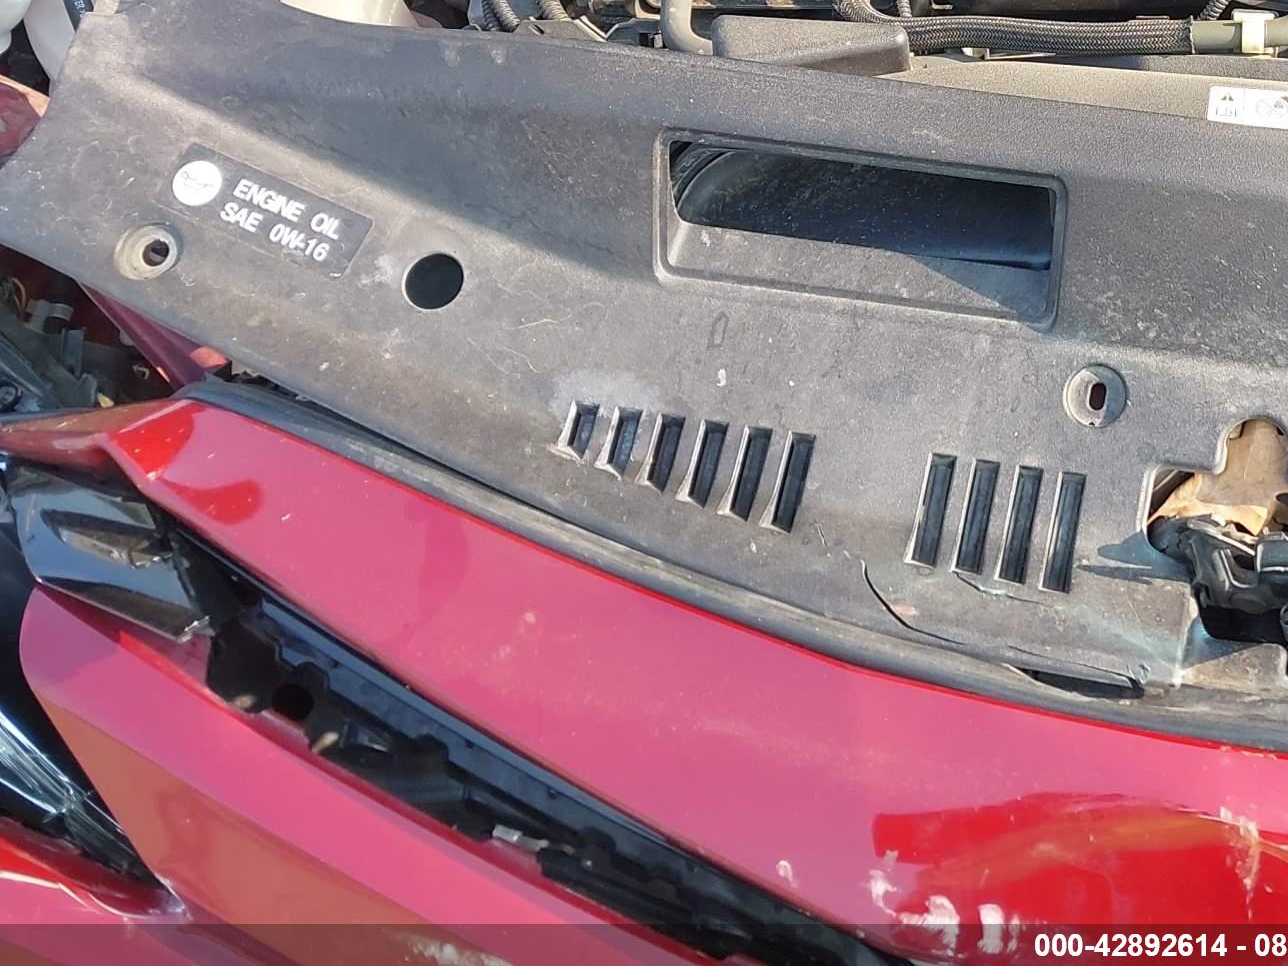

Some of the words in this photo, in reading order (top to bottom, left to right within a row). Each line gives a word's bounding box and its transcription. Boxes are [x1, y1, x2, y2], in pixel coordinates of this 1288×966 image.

[220, 202, 263, 233] SAE
[269, 222, 330, 262] 0W-16
[232, 179, 306, 222] ENGINE
[310, 212, 341, 240] OIL
